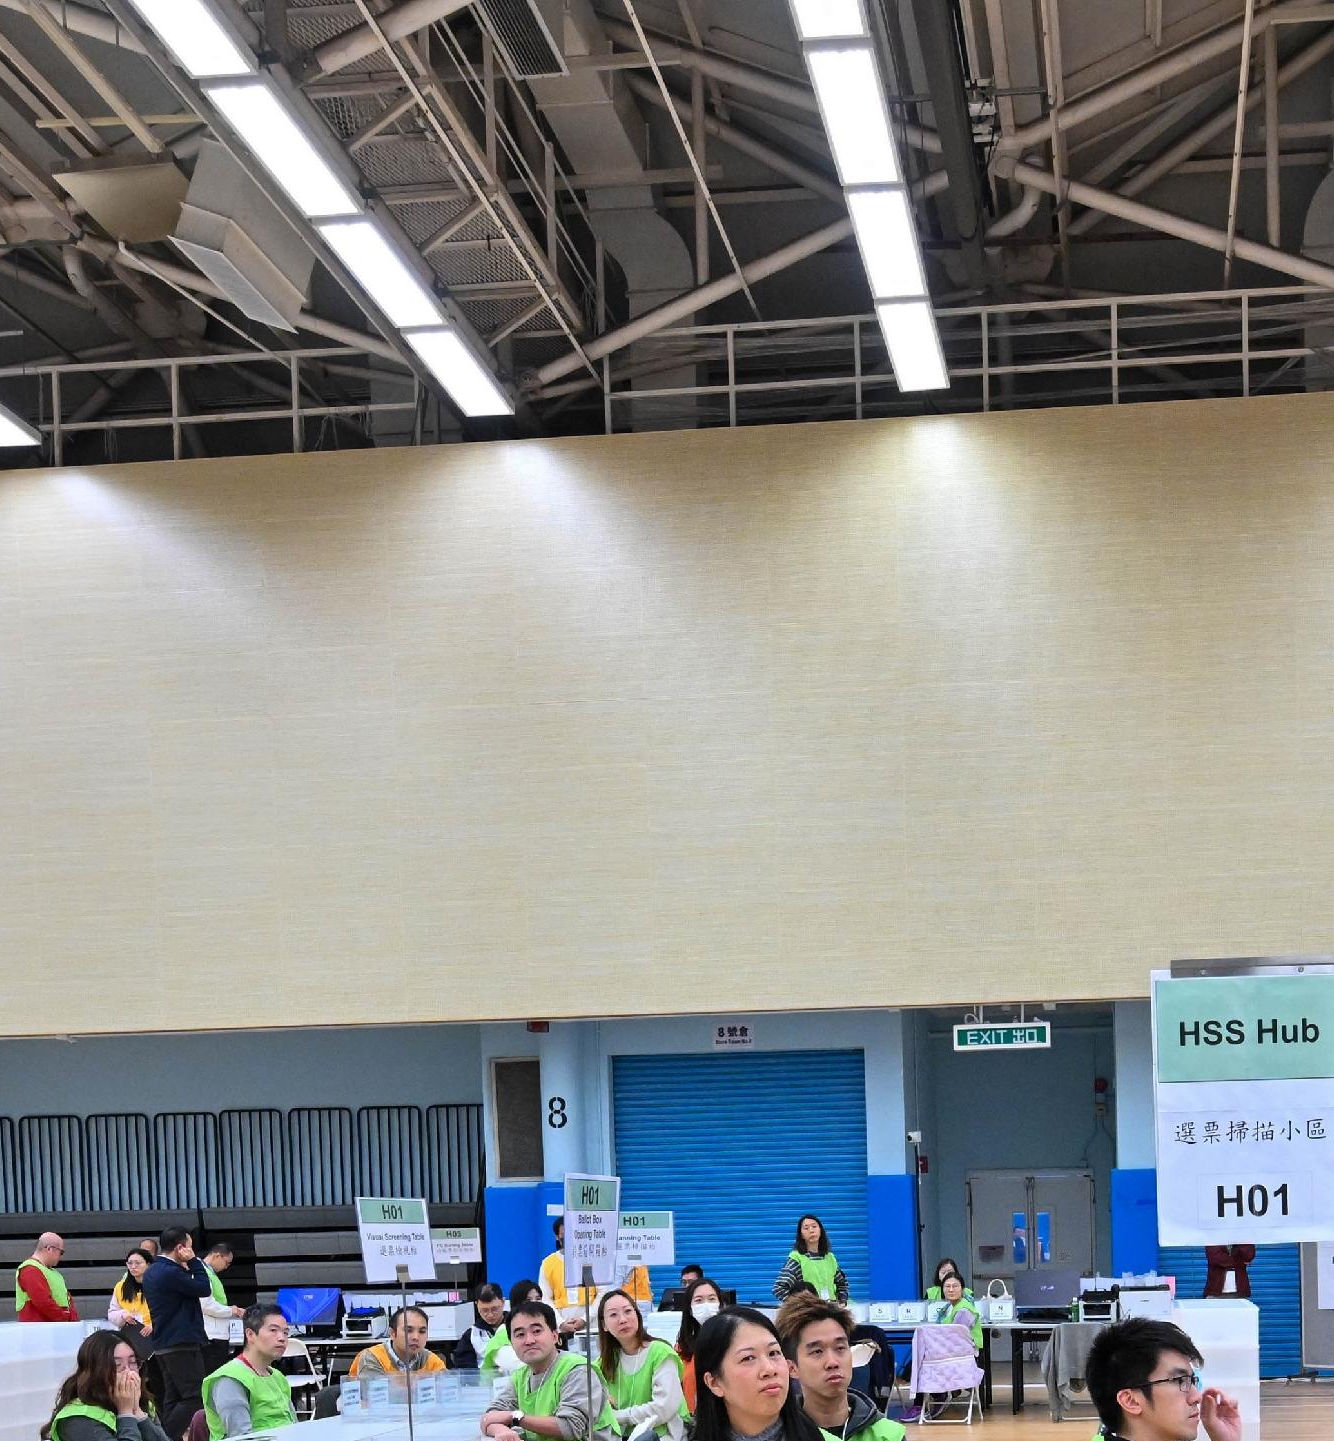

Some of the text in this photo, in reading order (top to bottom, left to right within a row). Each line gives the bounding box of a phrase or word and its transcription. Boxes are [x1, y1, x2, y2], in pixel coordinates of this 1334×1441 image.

[967, 1029, 1037, 1044] EXIT 出口
[1179, 1018, 1319, 1046] HSS Hub
[548, 1096, 567, 1128] 8
[1174, 1118, 1327, 1145] 選票掃描小區
[581, 1186, 599, 1205] H01
[1217, 1183, 1289, 1218] H01
[382, 1204, 403, 1220] H01
[623, 1216, 646, 1226] H01
